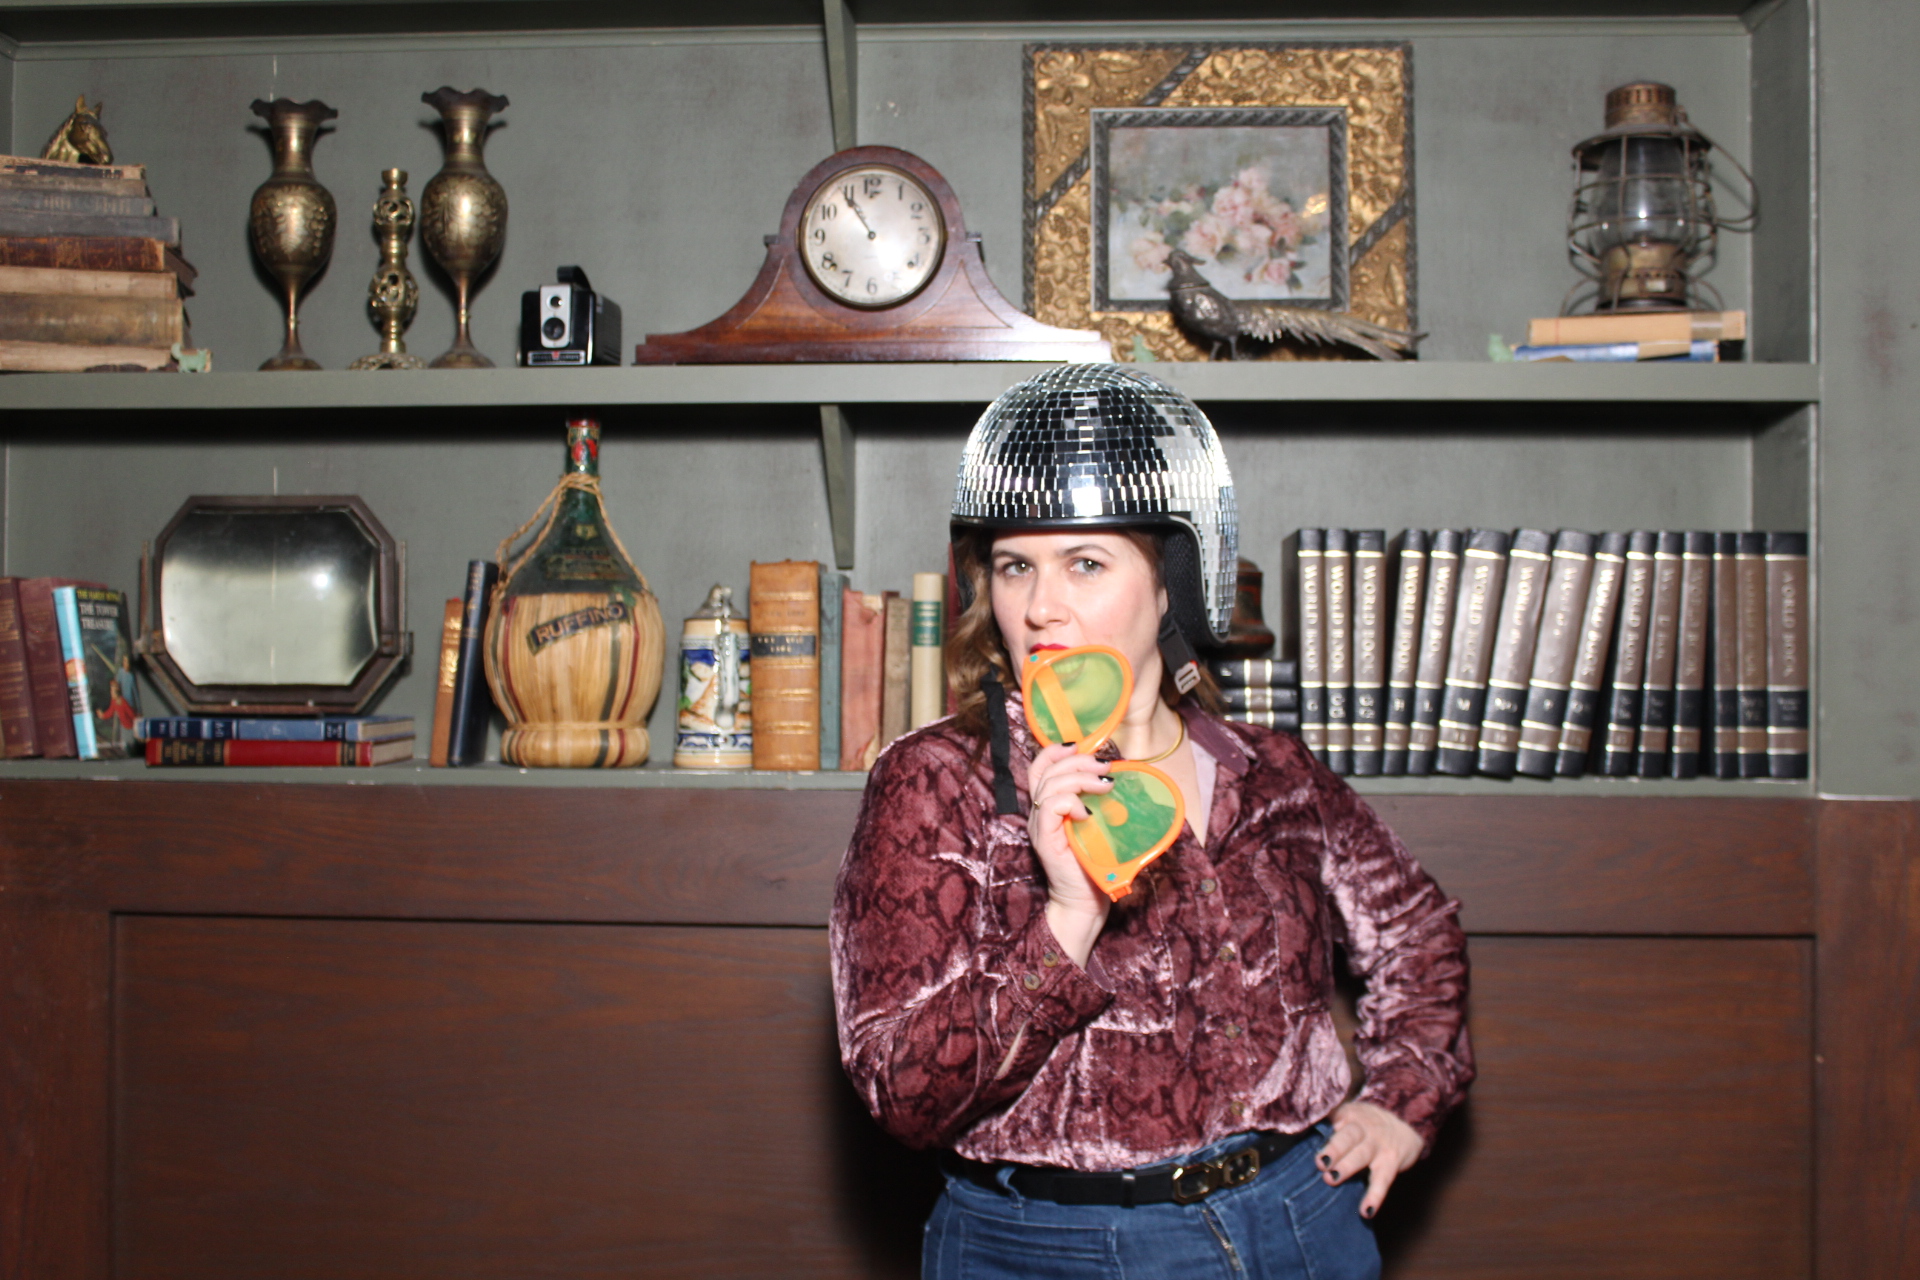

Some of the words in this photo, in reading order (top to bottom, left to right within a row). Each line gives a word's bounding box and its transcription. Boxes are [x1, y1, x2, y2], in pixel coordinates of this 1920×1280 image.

[863, 178, 882, 200] 12
[898, 182, 904, 201] 1
[821, 204, 837, 221] 10
[814, 228, 826, 246] 9
[821, 252, 834, 271] 8
[841, 269, 853, 287] 7
[866, 277, 878, 295] 6
[78, 602, 95, 616] THE
[94, 604, 119, 617] TOWER
[1304, 564, 1319, 625] WORLD
[1330, 564, 1345, 625] WORLD
[1361, 564, 1377, 625] WORLD
[1400, 565, 1419, 625] WORLD
[1430, 566, 1451, 626] WORLD
[1468, 565, 1489, 625] WORLD
[1590, 569, 1616, 628] WORLD
[1627, 568, 1647, 628] WORLD
[535, 602, 624, 645] RUFFINO
[1305, 628, 1319, 673] BOOK
[1330, 628, 1345, 674] BOOK
[1396, 628, 1413, 673] BOOK
[1580, 630, 1601, 677] BOOK
